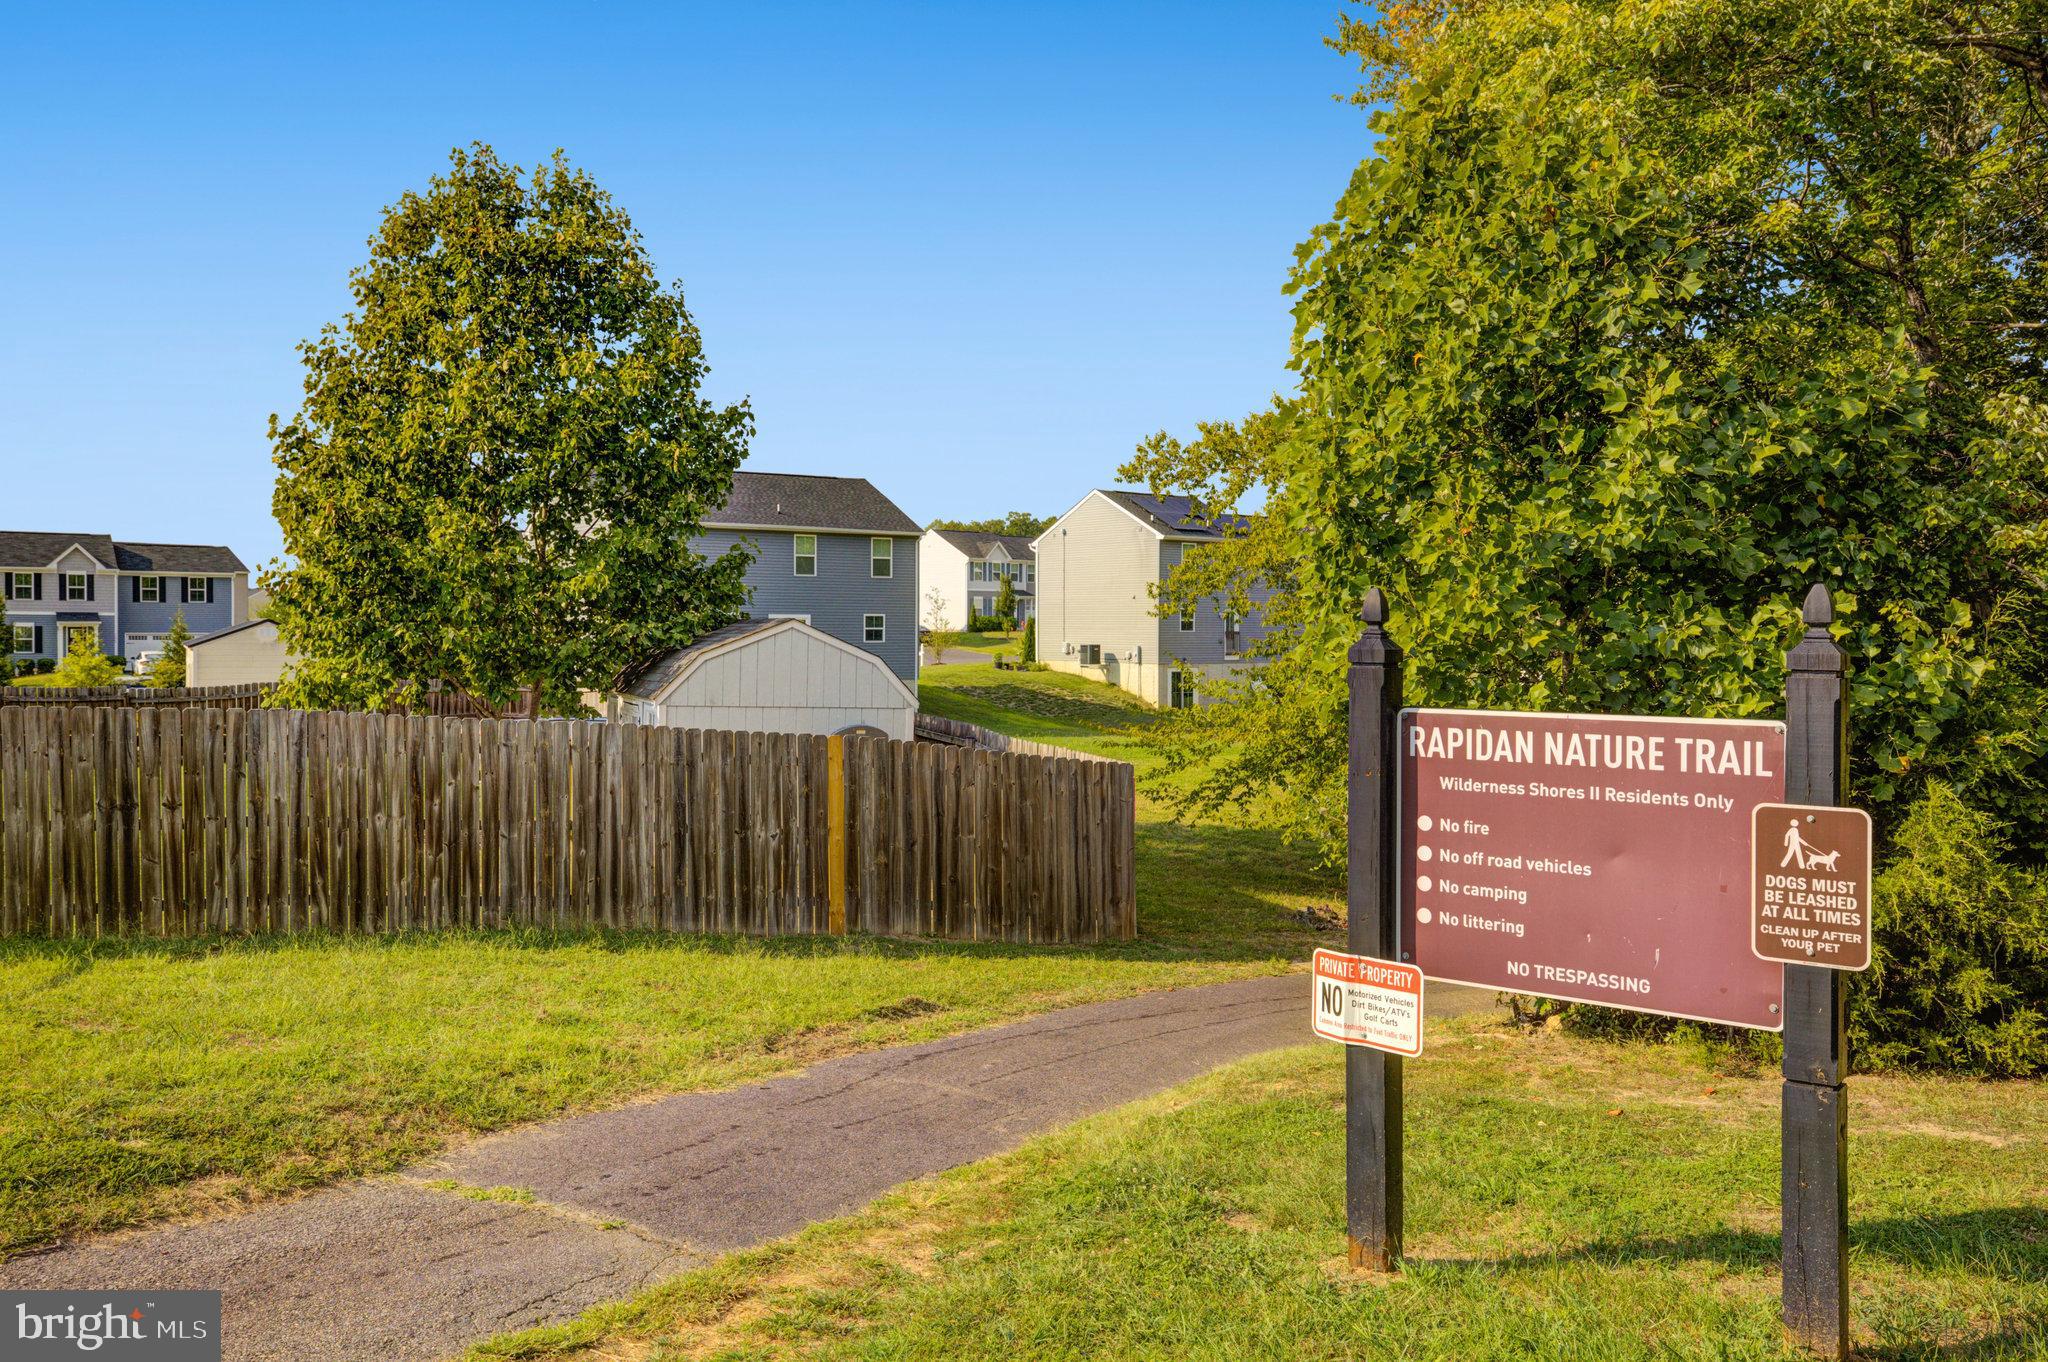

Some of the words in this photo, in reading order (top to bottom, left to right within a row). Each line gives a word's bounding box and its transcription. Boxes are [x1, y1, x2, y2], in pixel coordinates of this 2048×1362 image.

[1410, 726, 1534, 763] RAPIDAN
[1545, 732, 1664, 771] NATURE
[1675, 738, 1773, 777] TRAIL
[1439, 776, 1525, 796] Wilderness
[1529, 781, 1585, 800] Shores
[1605, 788, 1689, 807] Residents
[1694, 792, 1734, 813] Only
[1440, 818, 1460, 834] No
[1463, 820, 1489, 836] fire
[1440, 848, 1460, 863] No
[1463, 850, 1484, 866] off
[1487, 854, 1522, 869] road
[1525, 857, 1592, 876] vehicles
[1439, 879, 1460, 894] No
[1463, 884, 1528, 905] camping
[1766, 875, 1806, 890] DOGS
[1812, 879, 1856, 894] MUST
[1765, 890, 1783, 903] BE
[1789, 892, 1857, 909] LEASHED
[1439, 911, 1460, 927] No
[1463, 913, 1525, 938] littering
[1762, 905, 1779, 917] AT
[1783, 907, 1809, 921] ALL
[1814, 910, 1861, 926] TIMES
[1760, 925, 1798, 937] CLEAN
[1803, 929, 1818, 939] UP
[1822, 931, 1862, 943] AFTER
[1782, 938, 1814, 951] YOUR
[1817, 943, 1840, 953] PET
[1320, 957, 1355, 978] PRIVATE
[1359, 963, 1413, 988] PROPERTY
[1507, 960, 1529, 977] NO
[1534, 963, 1651, 994] TRESPASSING
[1322, 982, 1342, 1016] NO
[1348, 990, 1382, 1001] Motorized
[1385, 996, 1414, 1007] Vehicles
[1352, 1000, 1365, 1009] Dirt
[1364, 1013, 1378, 1022] Golf
[1380, 1016, 1398, 1026] Carts
